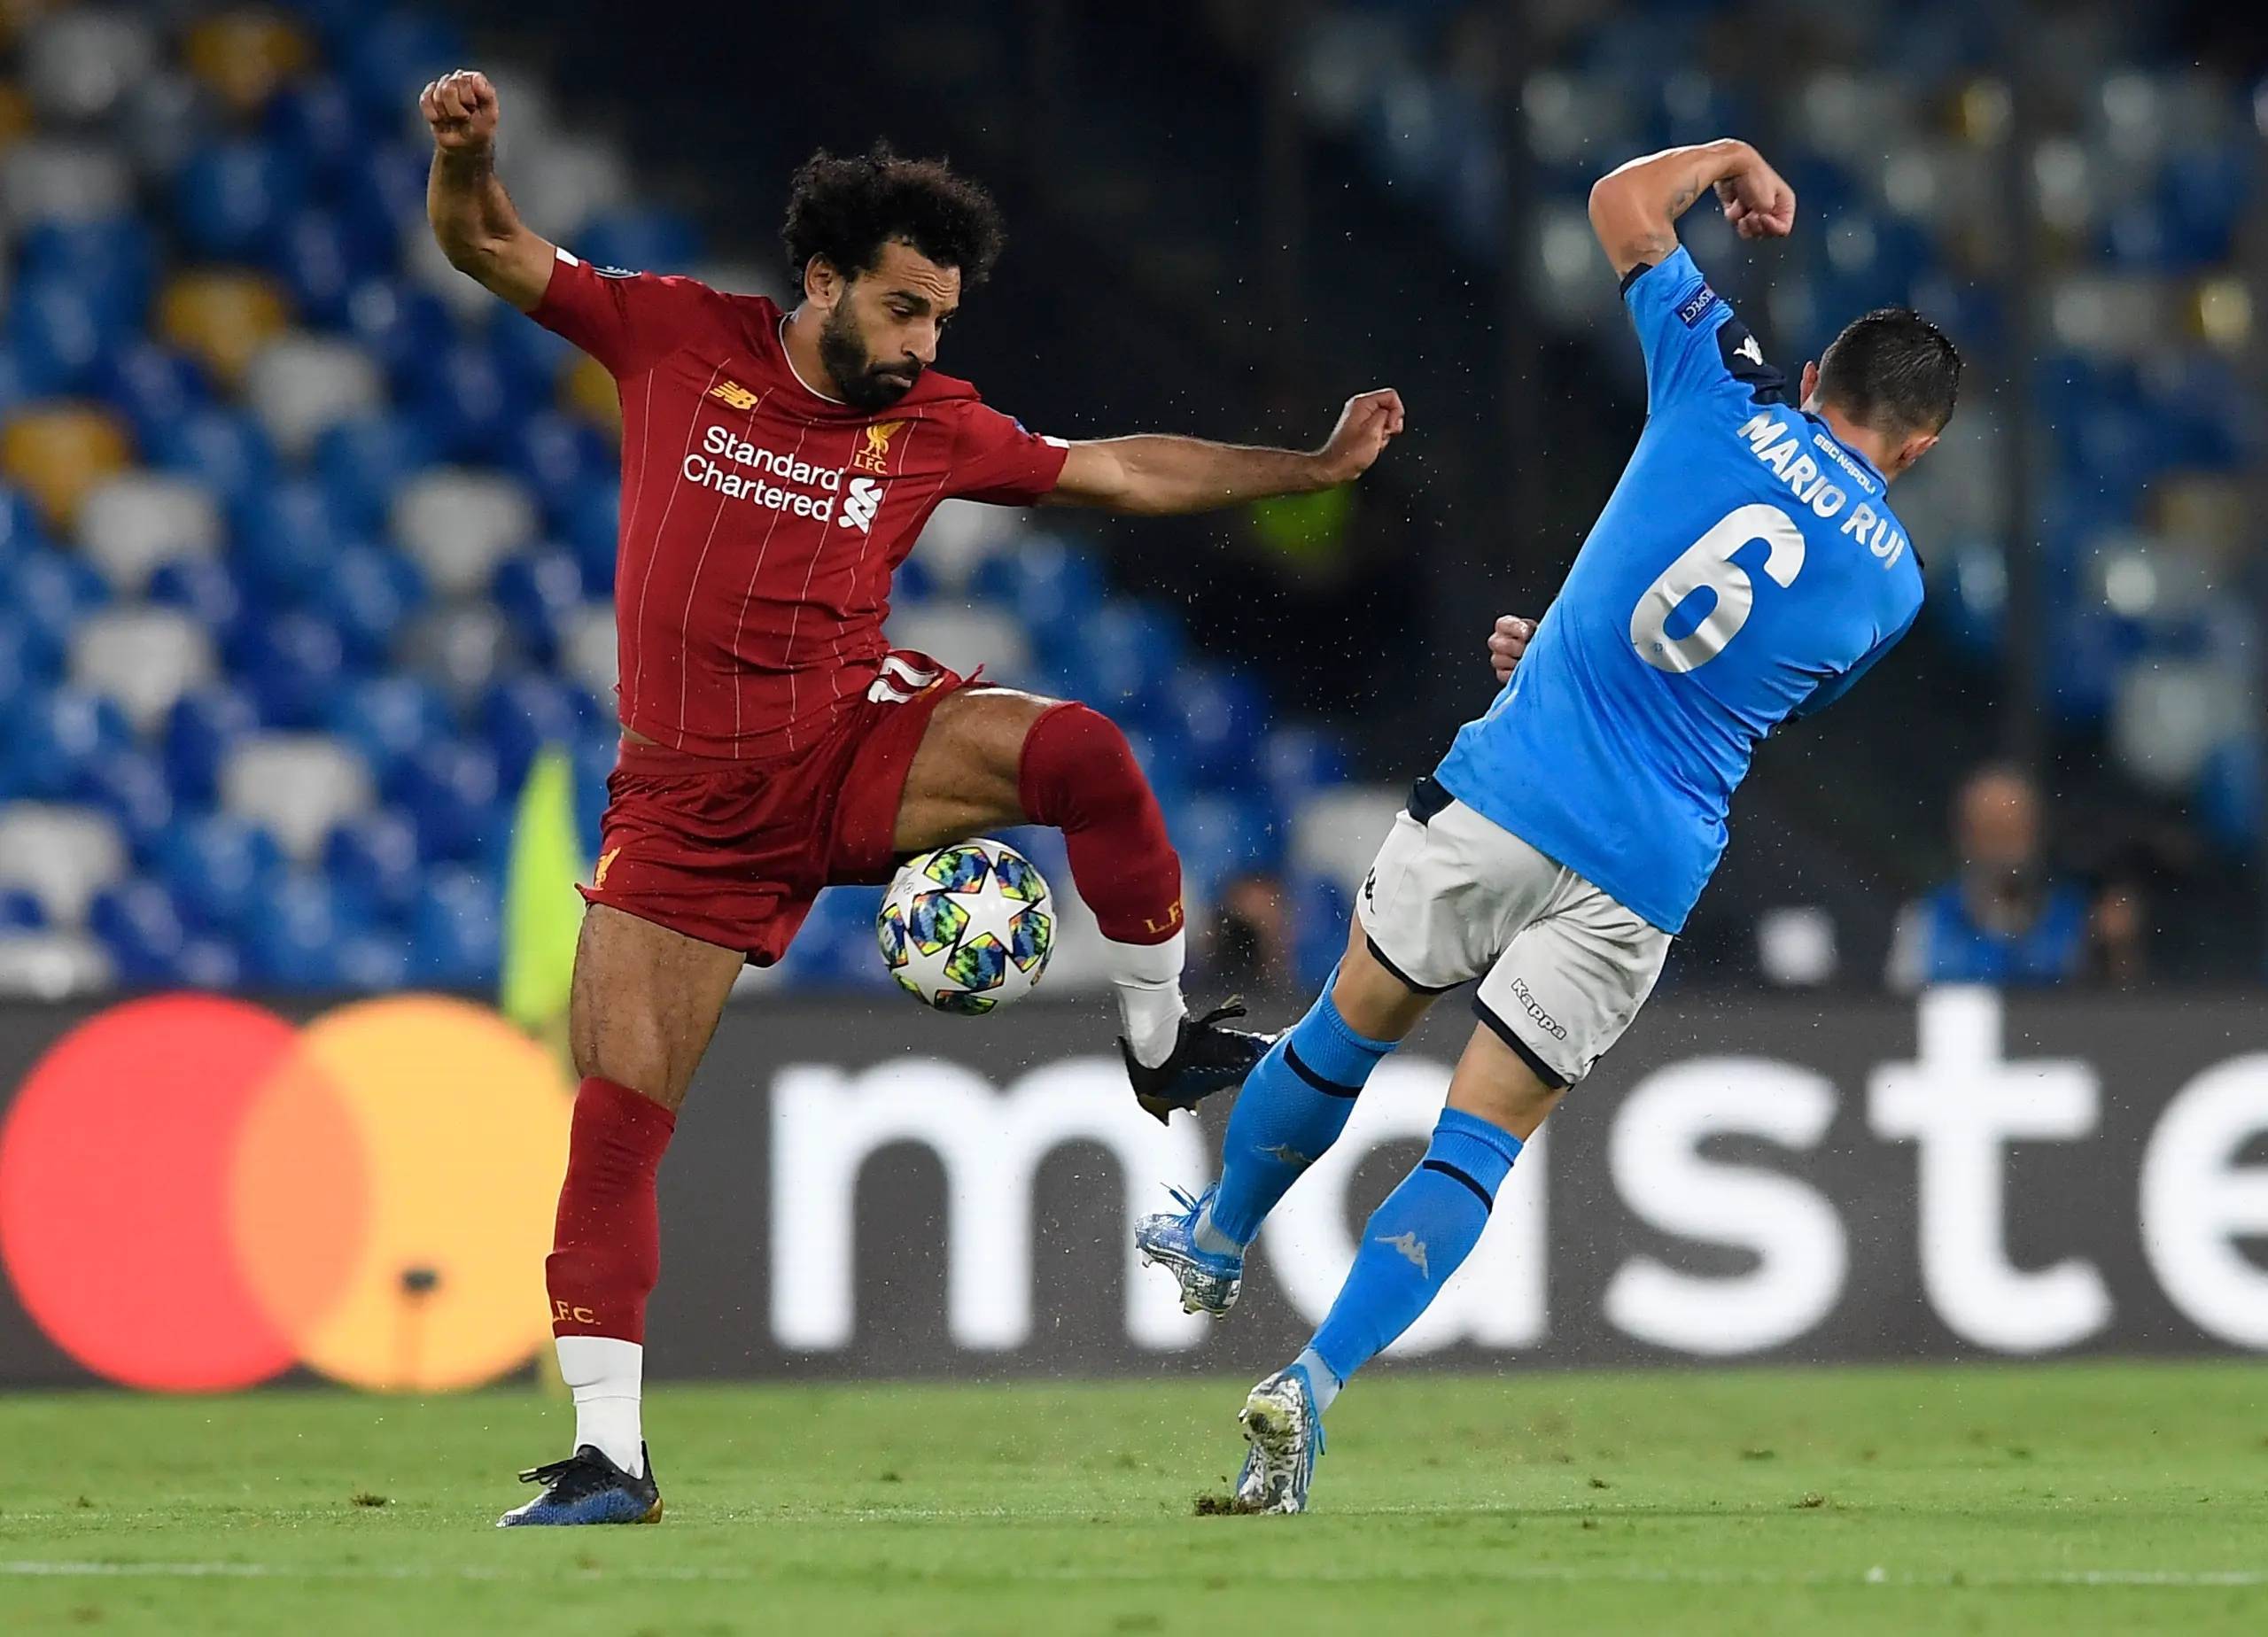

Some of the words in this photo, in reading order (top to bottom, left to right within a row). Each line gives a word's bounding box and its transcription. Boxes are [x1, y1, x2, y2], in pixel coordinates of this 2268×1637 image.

[683, 454, 835, 523] Chartered
[703, 425, 845, 492] Standard
[1736, 411, 1846, 518] MARIO
[1840, 501, 1905, 570] RUI
[1630, 503, 1806, 673] 6
[1511, 978, 1567, 1040] Kappa
